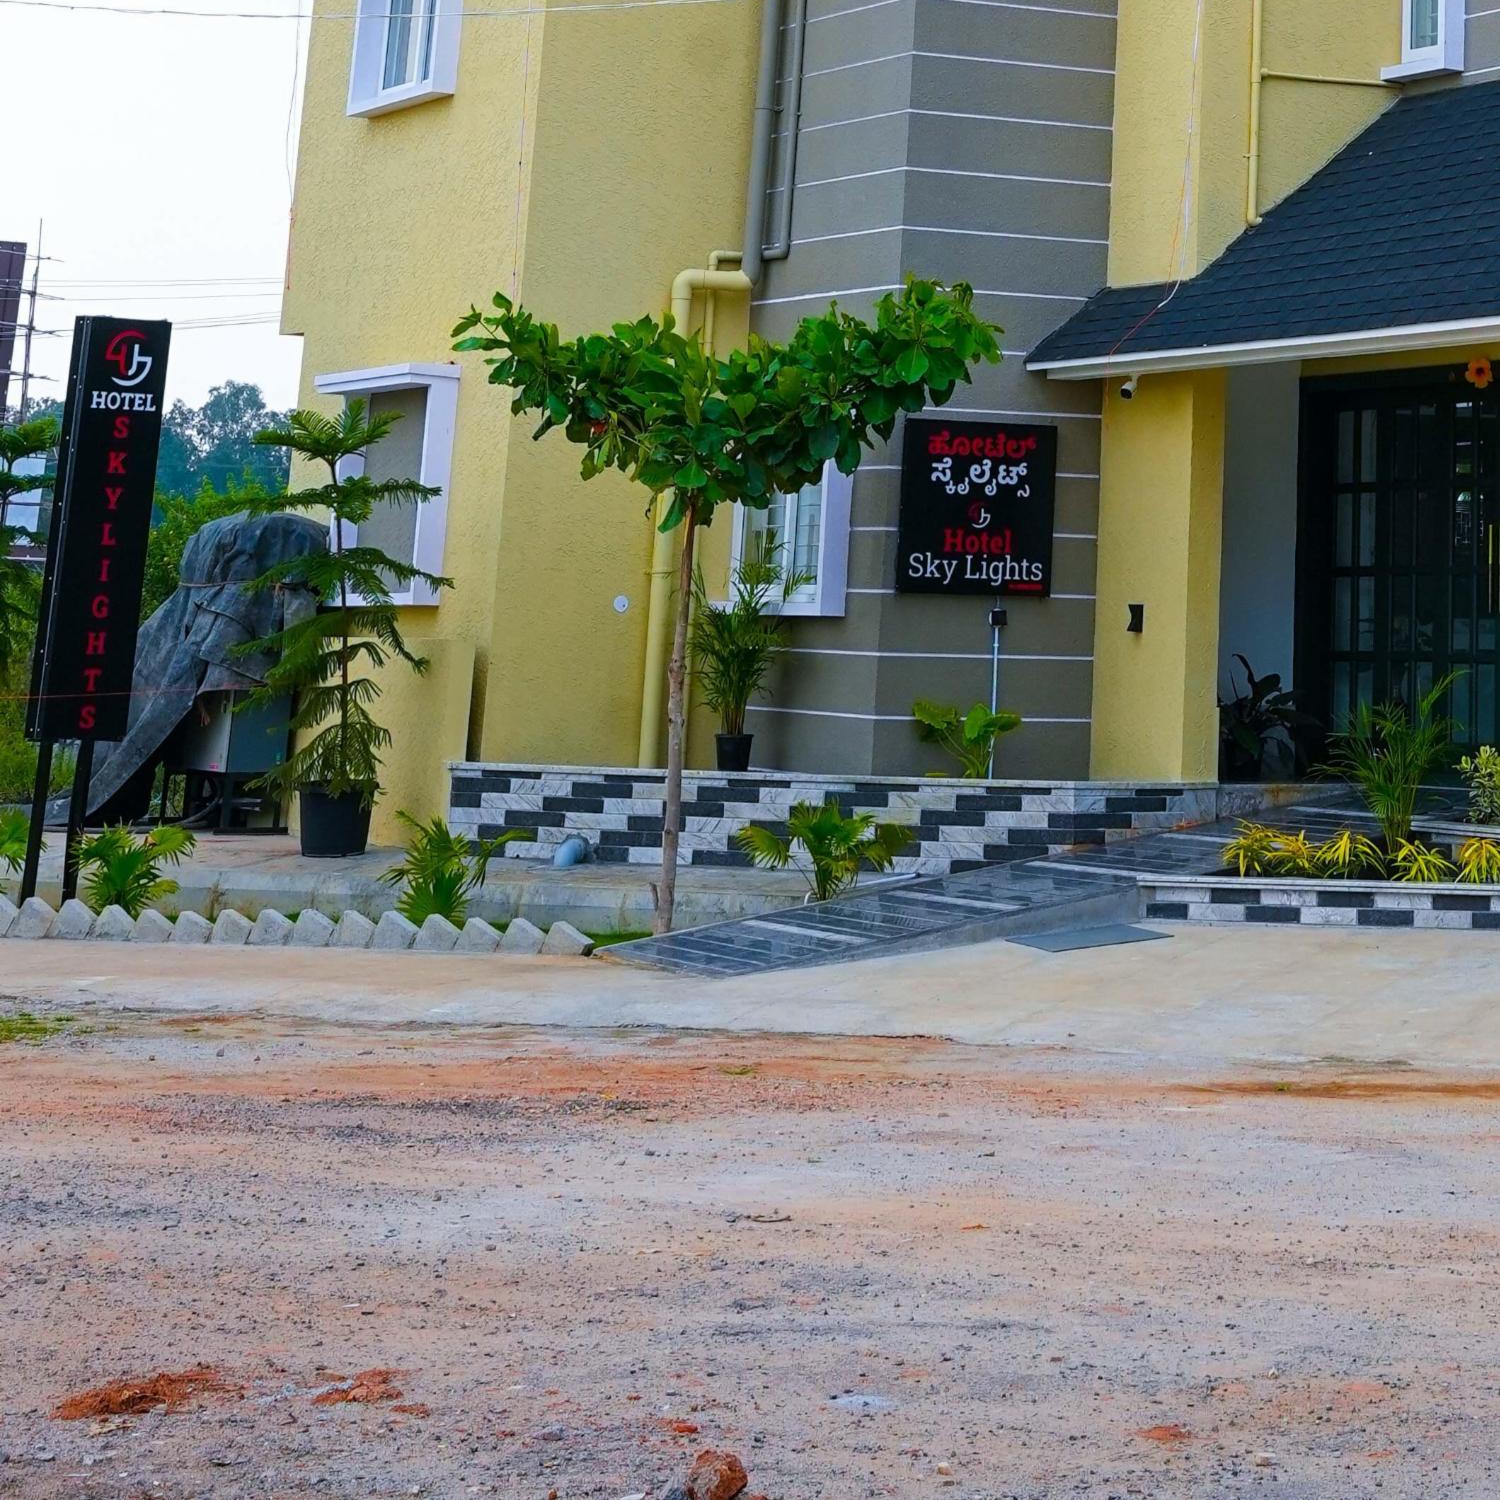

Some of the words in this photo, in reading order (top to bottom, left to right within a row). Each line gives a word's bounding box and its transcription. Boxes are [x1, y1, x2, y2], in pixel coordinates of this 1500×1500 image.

[90, 391, 156, 412] HOTEL
[928, 430, 1037, 458] ಹೋಟೆಲ್
[944, 528, 1012, 553] Hotel
[908, 552, 958, 584] Sky
[964, 554, 1042, 586] Lights
